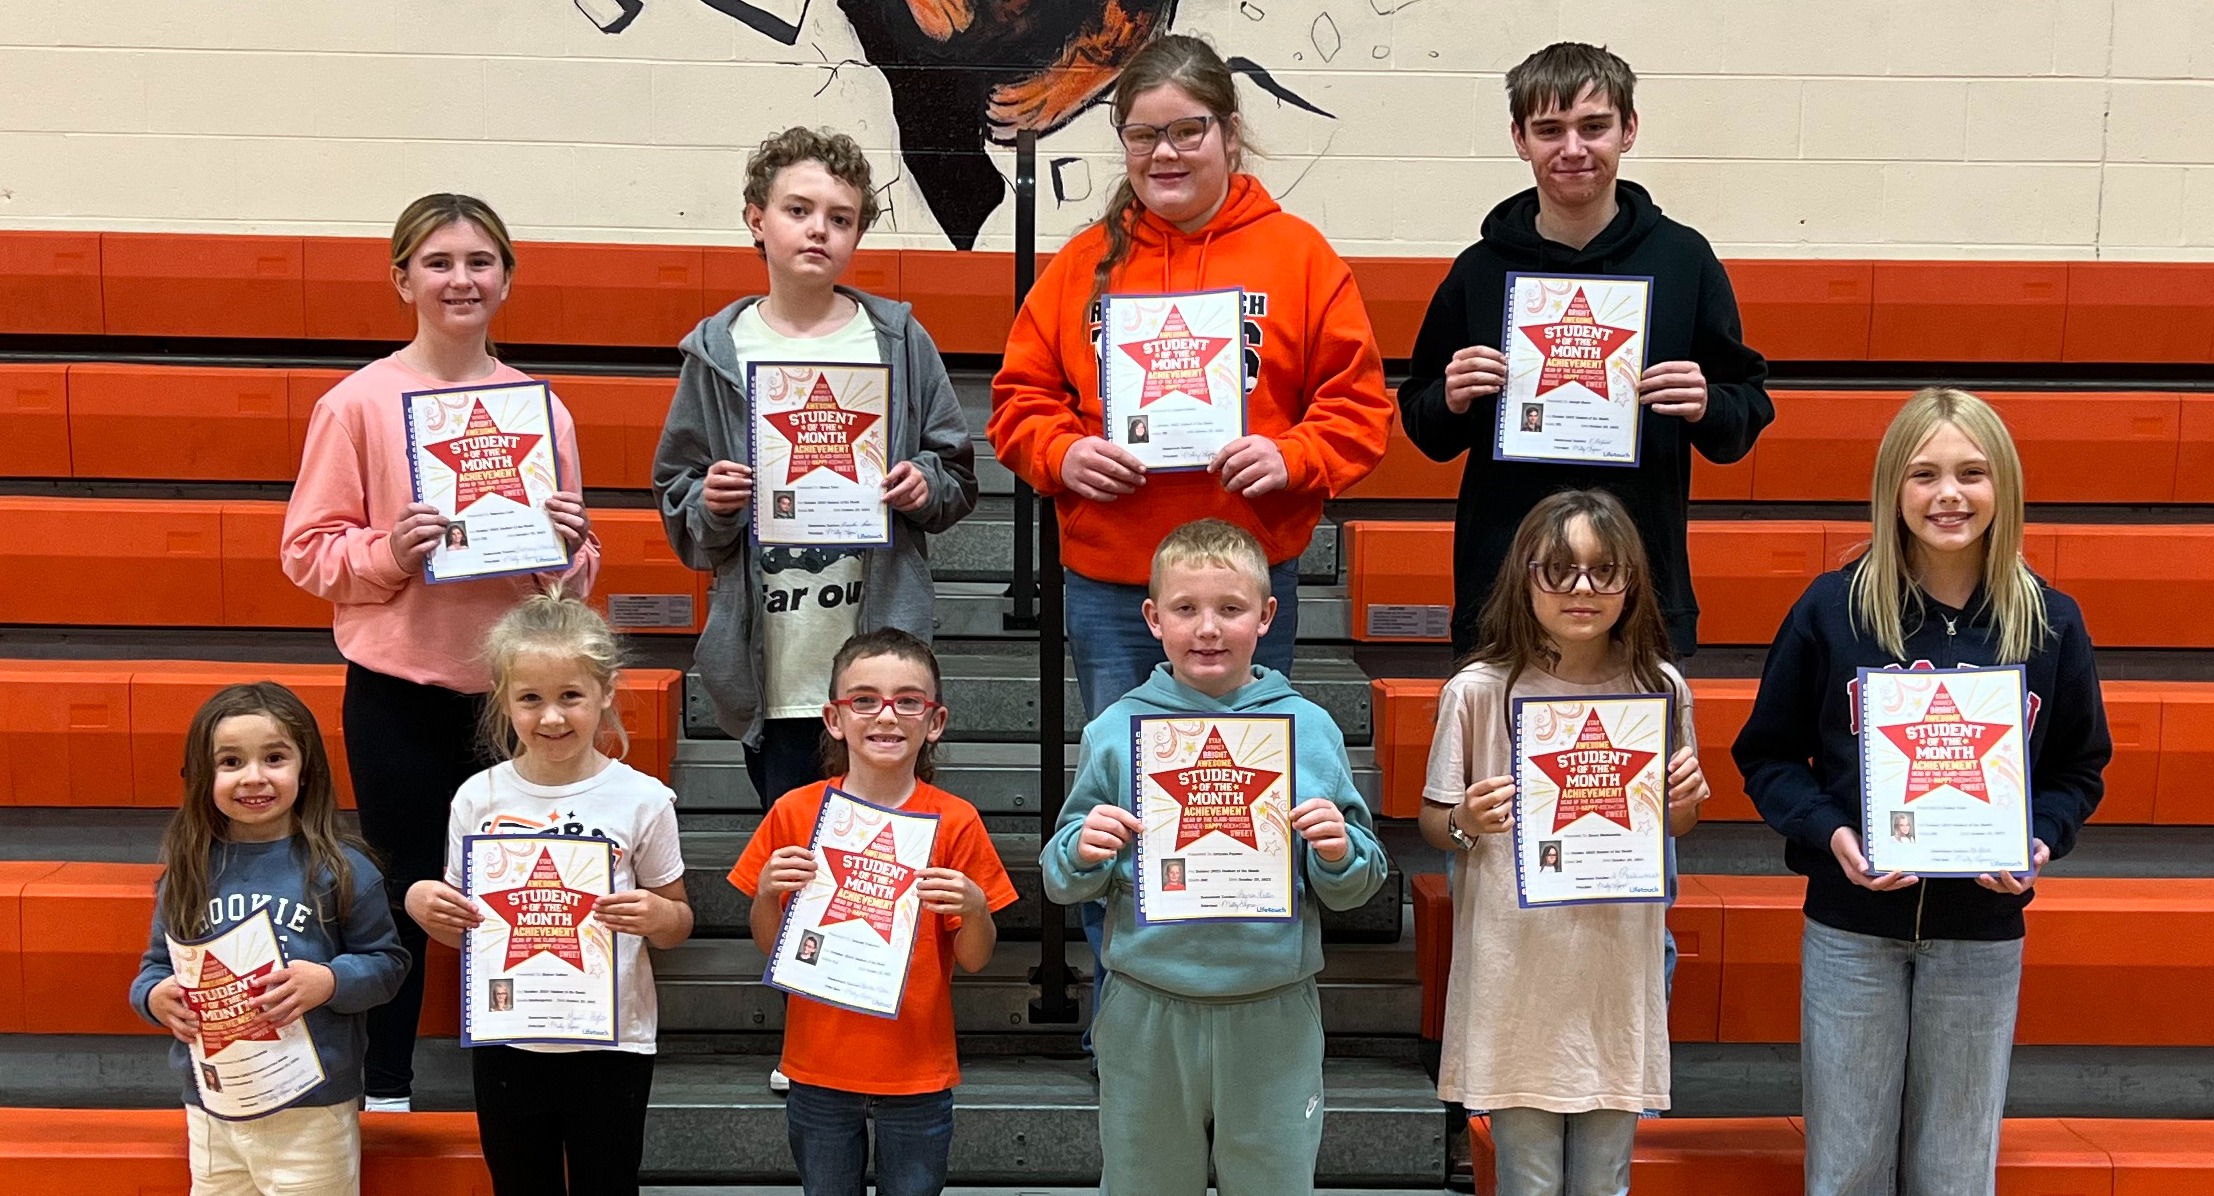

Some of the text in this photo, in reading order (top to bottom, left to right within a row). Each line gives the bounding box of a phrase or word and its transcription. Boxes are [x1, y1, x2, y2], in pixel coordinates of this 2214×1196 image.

[1544, 325, 1613, 341] STUDENT
[1143, 339, 1210, 354] STUDENT
[1550, 345, 1601, 359] MONTH
[1175, 350, 1190, 358] THE
[1151, 357, 1200, 371] MONTH
[1546, 357, 1602, 369] ACHIEVEMENT
[1147, 369, 1202, 379] ACHIEVEMENT
[789, 411, 856, 425] STUDENT
[797, 432, 846, 443] MONTH
[450, 436, 520, 455] STUDENT
[794, 444, 849, 453] ACHIEVEMENT
[470, 449, 500, 458] OF THE
[461, 456, 513, 472] MONTH
[459, 468, 517, 482] ACHIEVEMENT
[818, 581, 863, 608] ou
[1905, 723, 1985, 739] STUDENT
[1557, 751, 1631, 767] STUDENT
[1915, 746, 1974, 759] MONTH
[1590, 764, 1609, 772] THE
[1912, 760, 1977, 770] ACHIEVEMENT
[1178, 769, 1255, 784] STUDENT
[1565, 773, 1620, 787] MONTH
[1187, 792, 1243, 805] MONTH
[1561, 787, 1622, 798] ACHIEVEMENT
[1184, 806, 1247, 815] ACHIEVEMENT
[842, 855, 908, 882] STUDENT
[858, 872, 890, 885] OF THE
[844, 876, 897, 900] MONTH
[508, 889, 583, 906] STUDENT
[837, 889, 894, 911] ACHIEVEMENT
[529, 903, 541, 911] OF
[517, 912, 572, 926] MONTH
[513, 926, 575, 936] ACHIEVEMENT
[188, 974, 257, 1004] STUDENT
